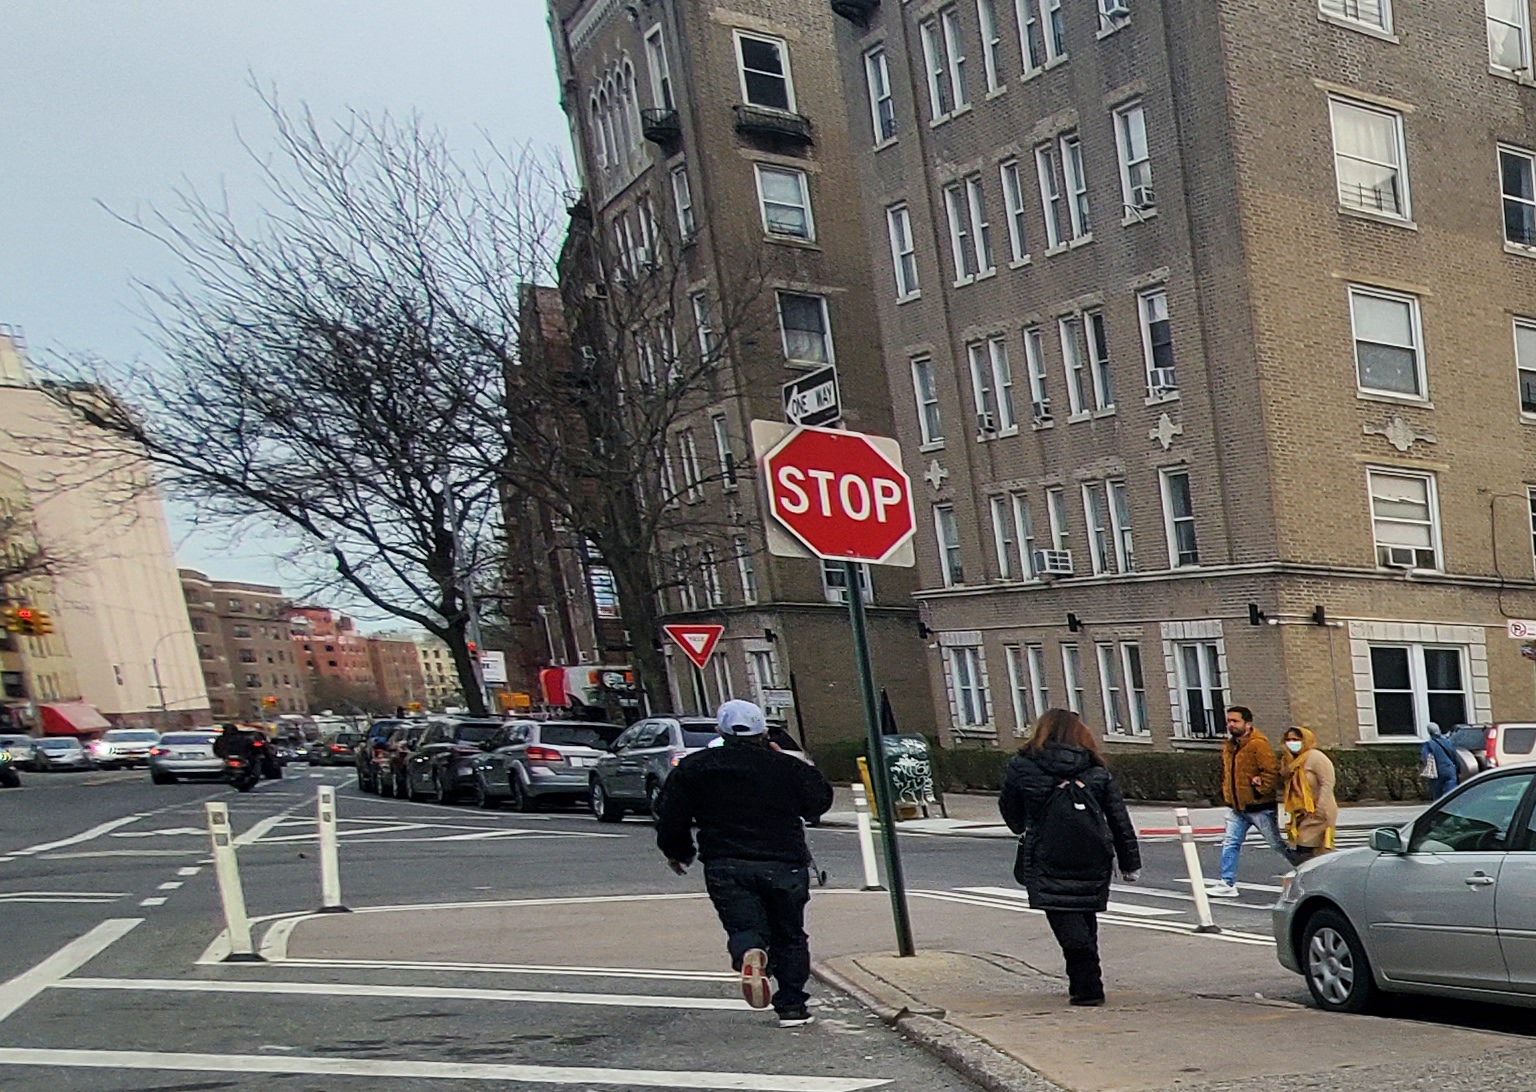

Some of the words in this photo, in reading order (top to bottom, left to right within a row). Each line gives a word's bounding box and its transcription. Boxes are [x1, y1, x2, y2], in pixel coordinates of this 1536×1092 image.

[791, 393, 809, 418] ONE
[815, 382, 833, 408] WAY
[777, 465, 902, 523] STOP
